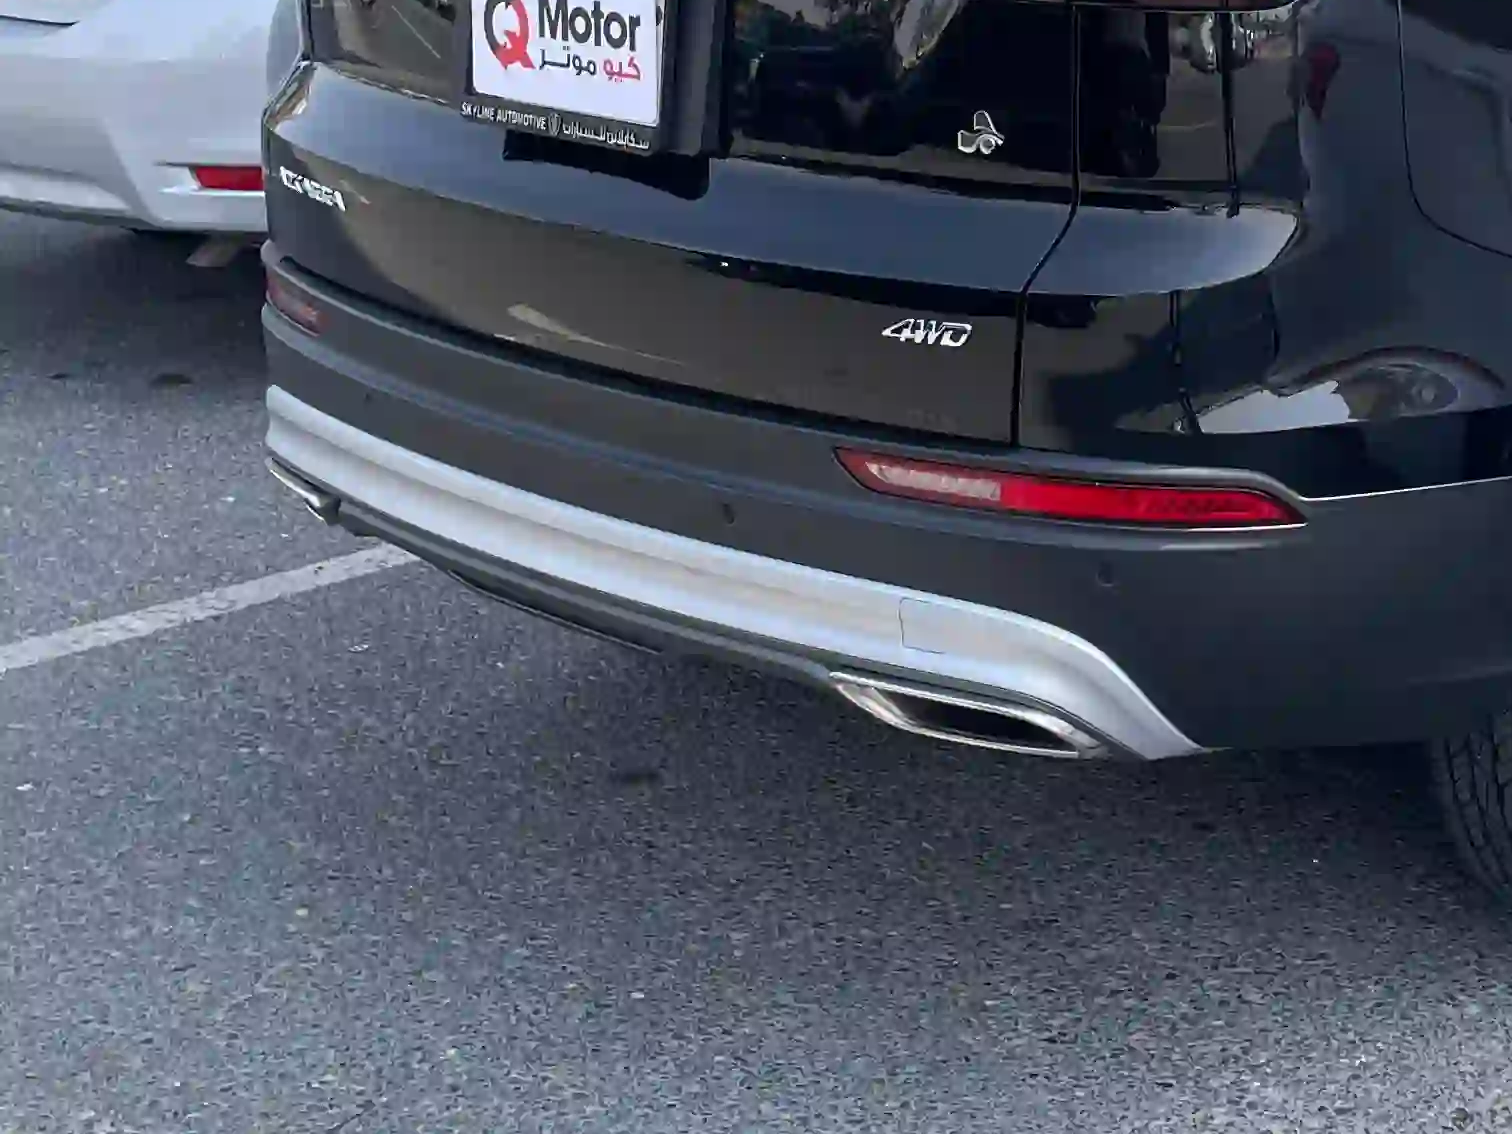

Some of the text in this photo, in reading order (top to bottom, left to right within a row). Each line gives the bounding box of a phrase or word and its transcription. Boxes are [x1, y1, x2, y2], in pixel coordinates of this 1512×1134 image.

[602, 53, 641, 83] كيو
[461, 102, 547, 131] SKYLINE AUTOMOTIVE
[881, 318, 973, 347] 4WD
